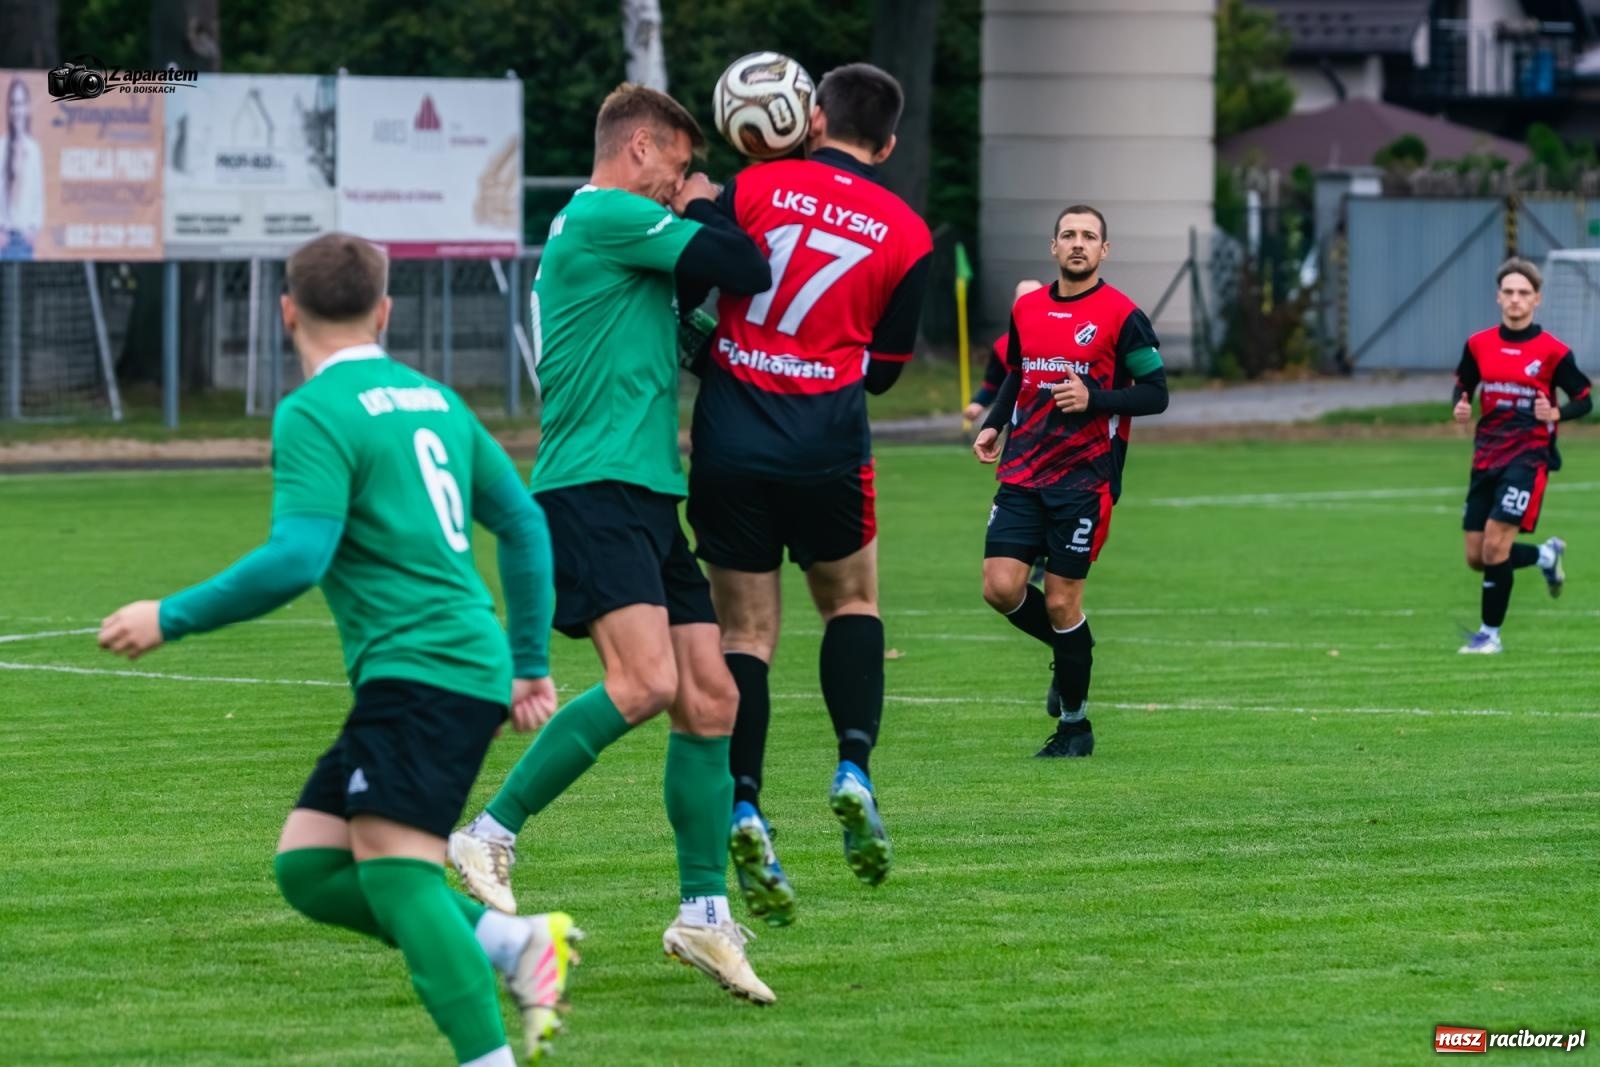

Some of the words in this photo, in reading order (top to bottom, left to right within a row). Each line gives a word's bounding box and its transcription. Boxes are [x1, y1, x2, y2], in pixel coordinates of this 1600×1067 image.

[772, 188, 818, 217] LKS
[822, 203, 889, 243] LYSKI
[745, 223, 873, 336] 17
[413, 427, 470, 553] 6
[1501, 486, 1531, 511] 20
[1072, 517, 1093, 545] 2
